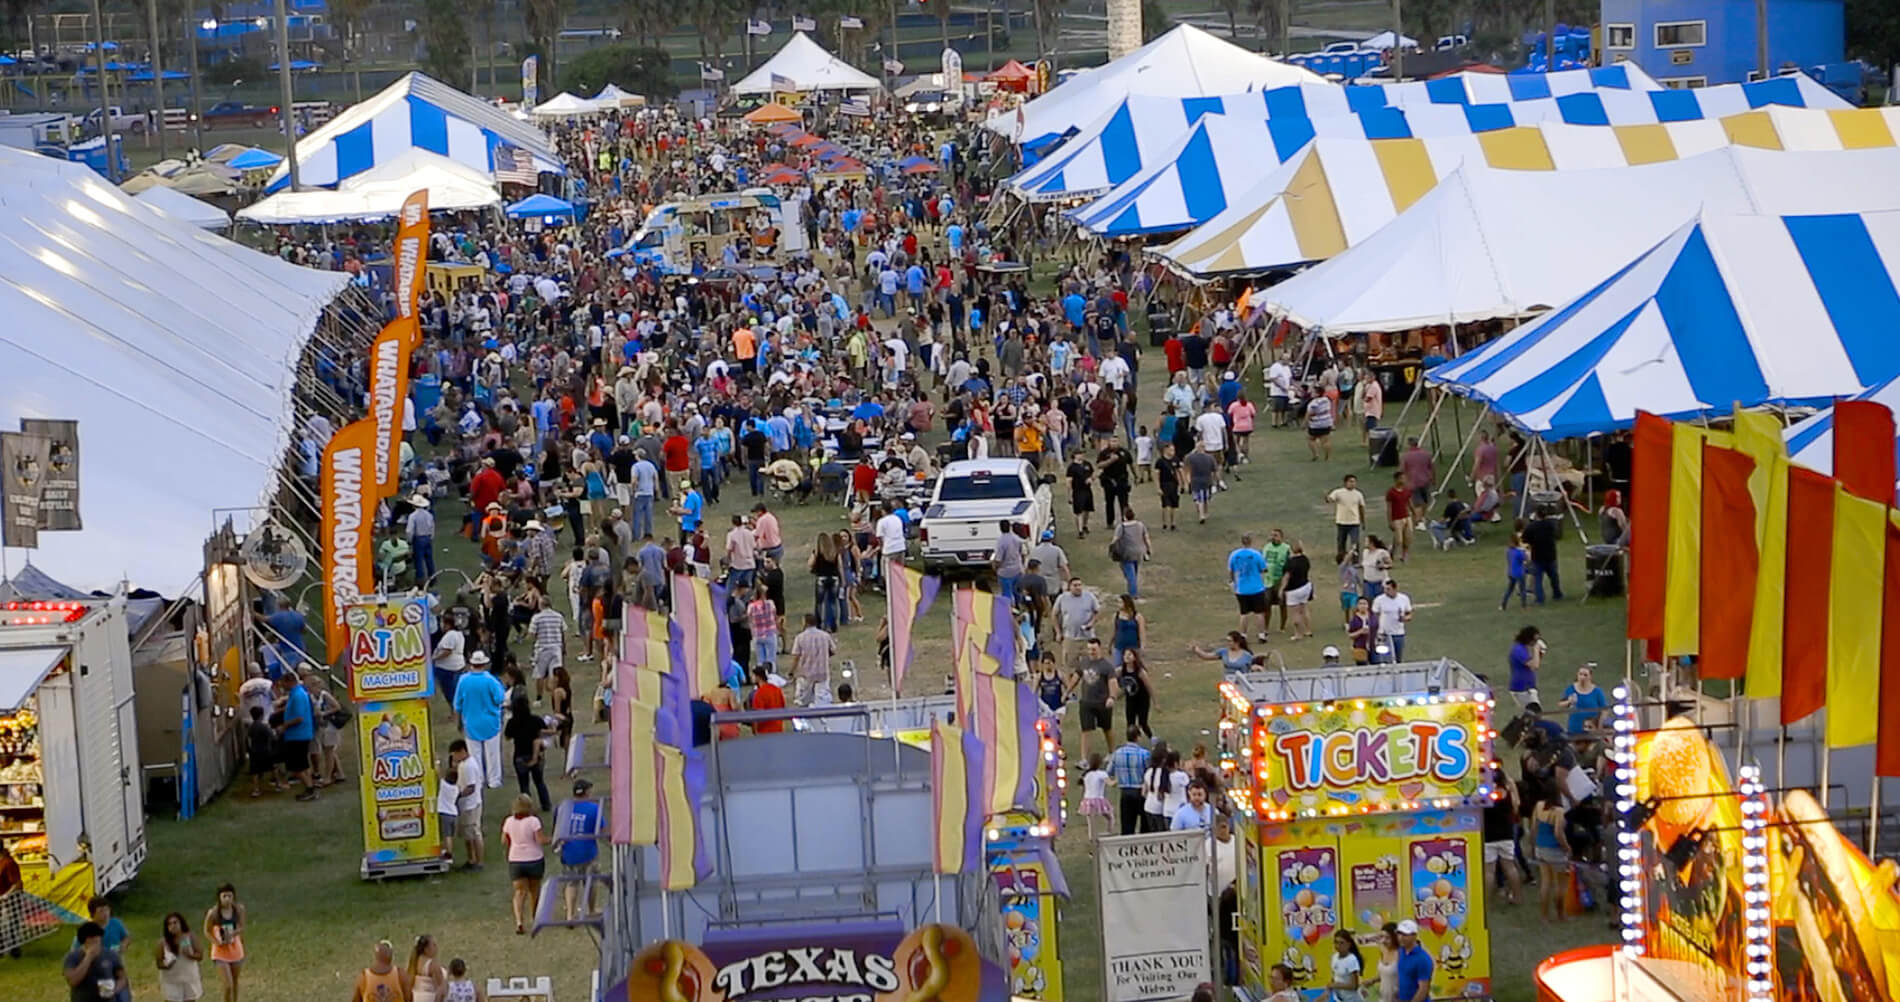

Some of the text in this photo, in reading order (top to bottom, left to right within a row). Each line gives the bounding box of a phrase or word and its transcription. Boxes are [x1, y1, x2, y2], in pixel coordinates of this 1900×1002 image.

[332, 447, 363, 625] WHATABURG
[352, 624, 425, 665] ATM
[362, 671, 419, 689] MACHINE
[1277, 720, 1471, 789] TICKETS
[373, 754, 425, 782] ATM
[376, 786, 424, 801] MACHINE
[1118, 839, 1189, 857] GRACIAS!
[1284, 909, 1337, 927] TICKETS
[1414, 898, 1467, 919] TICKETS
[1007, 931, 1040, 947] KETS
[715, 948, 900, 998] TEXAS
[1112, 954, 1204, 974] THANK YOU!
[1133, 972, 1173, 983] Visiting
[1138, 984, 1177, 995] Midway
